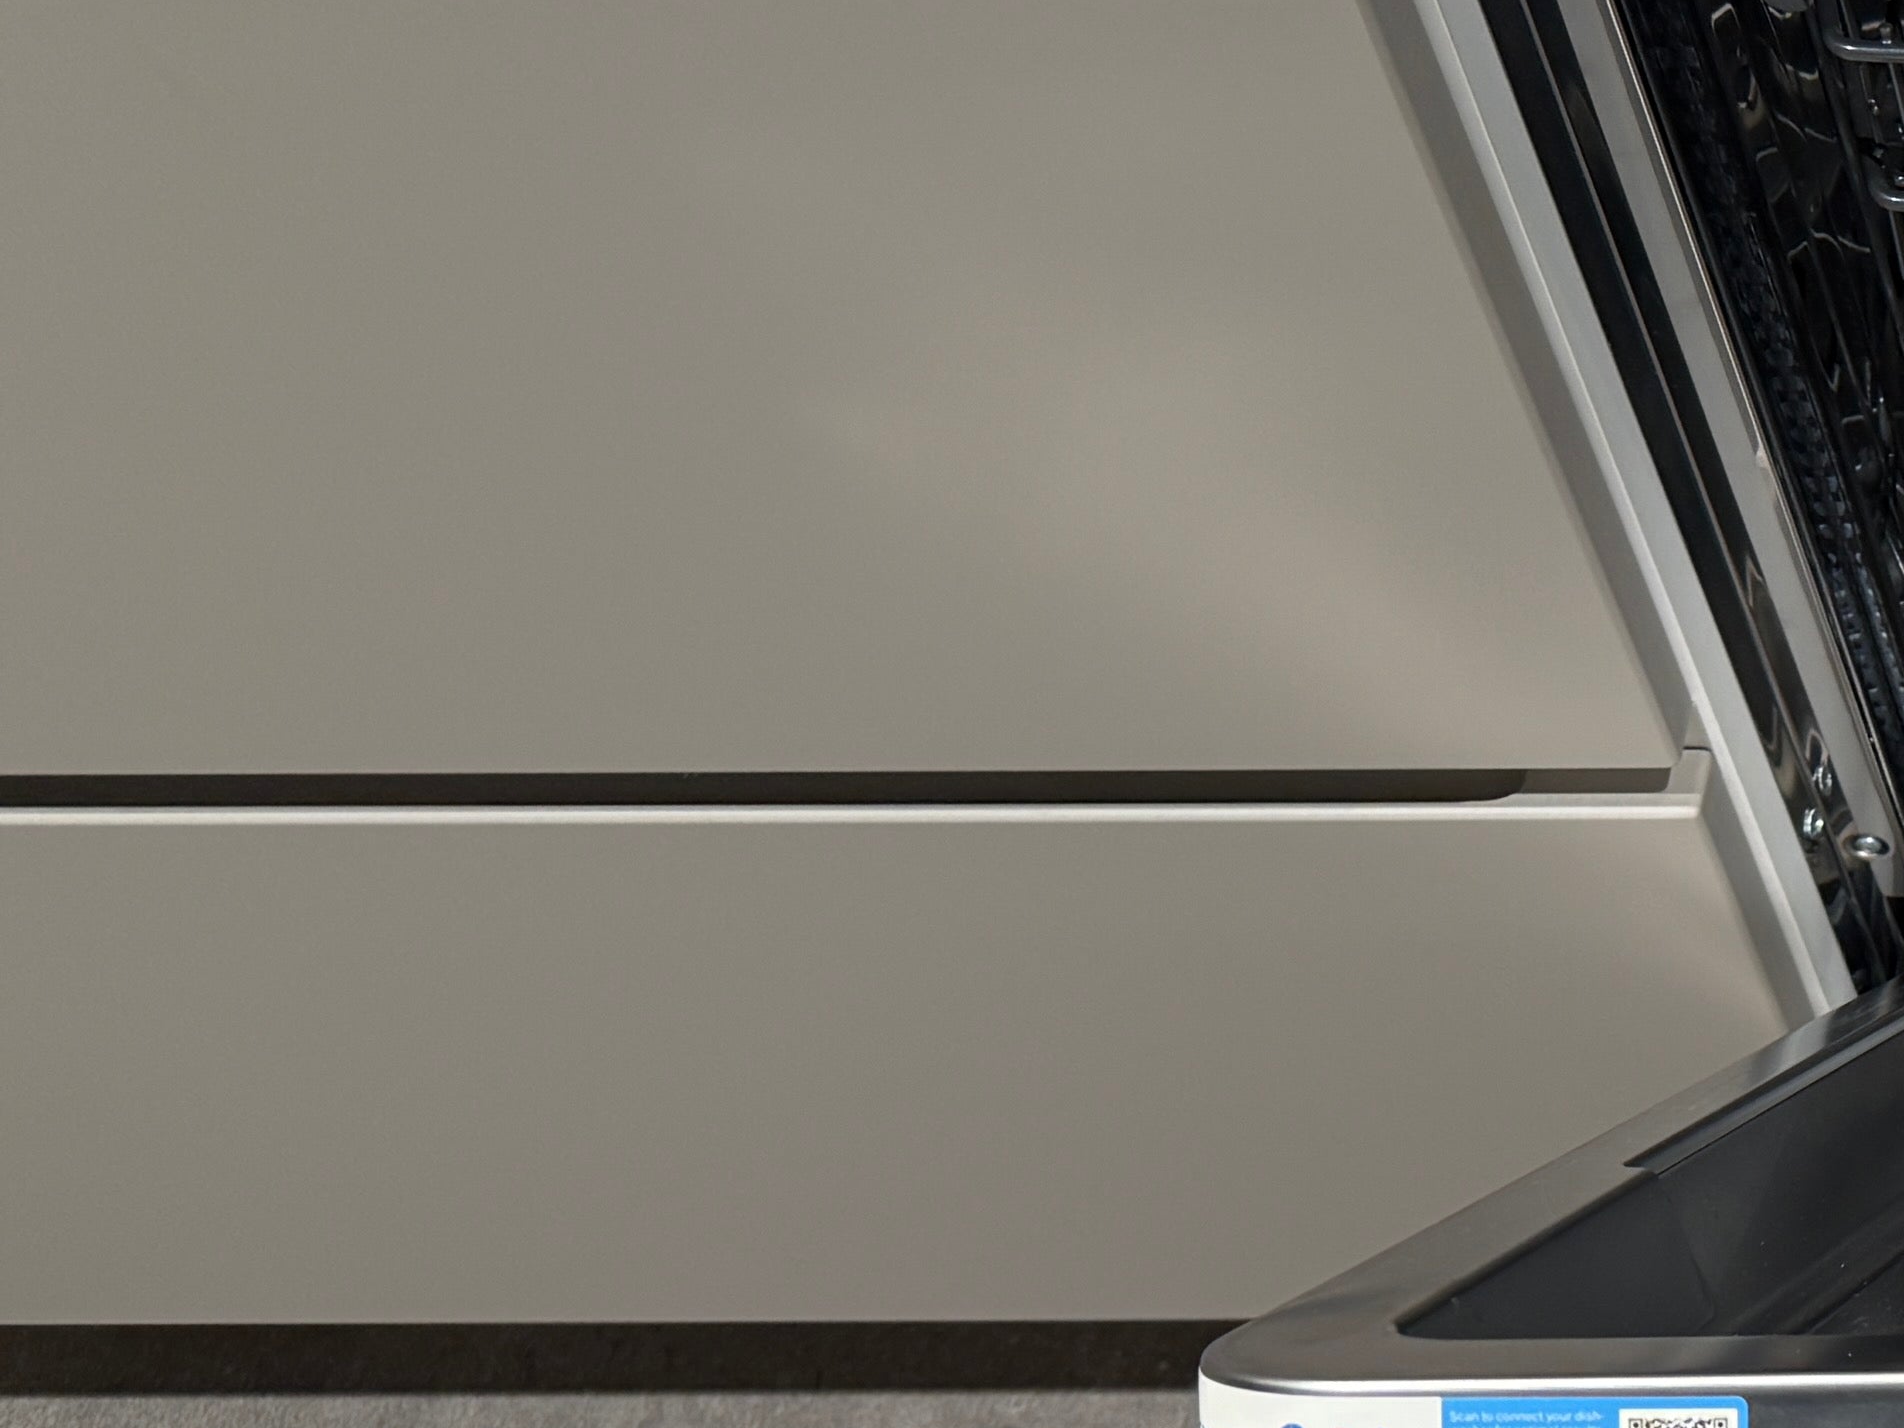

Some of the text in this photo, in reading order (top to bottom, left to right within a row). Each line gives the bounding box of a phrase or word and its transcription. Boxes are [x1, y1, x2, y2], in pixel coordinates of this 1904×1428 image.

[1450, 1410, 1480, 1423] Scan
[1481, 1410, 1495, 1422] to
[1496, 1411, 1544, 1423] connect
[1546, 1412, 1572, 1425] your
